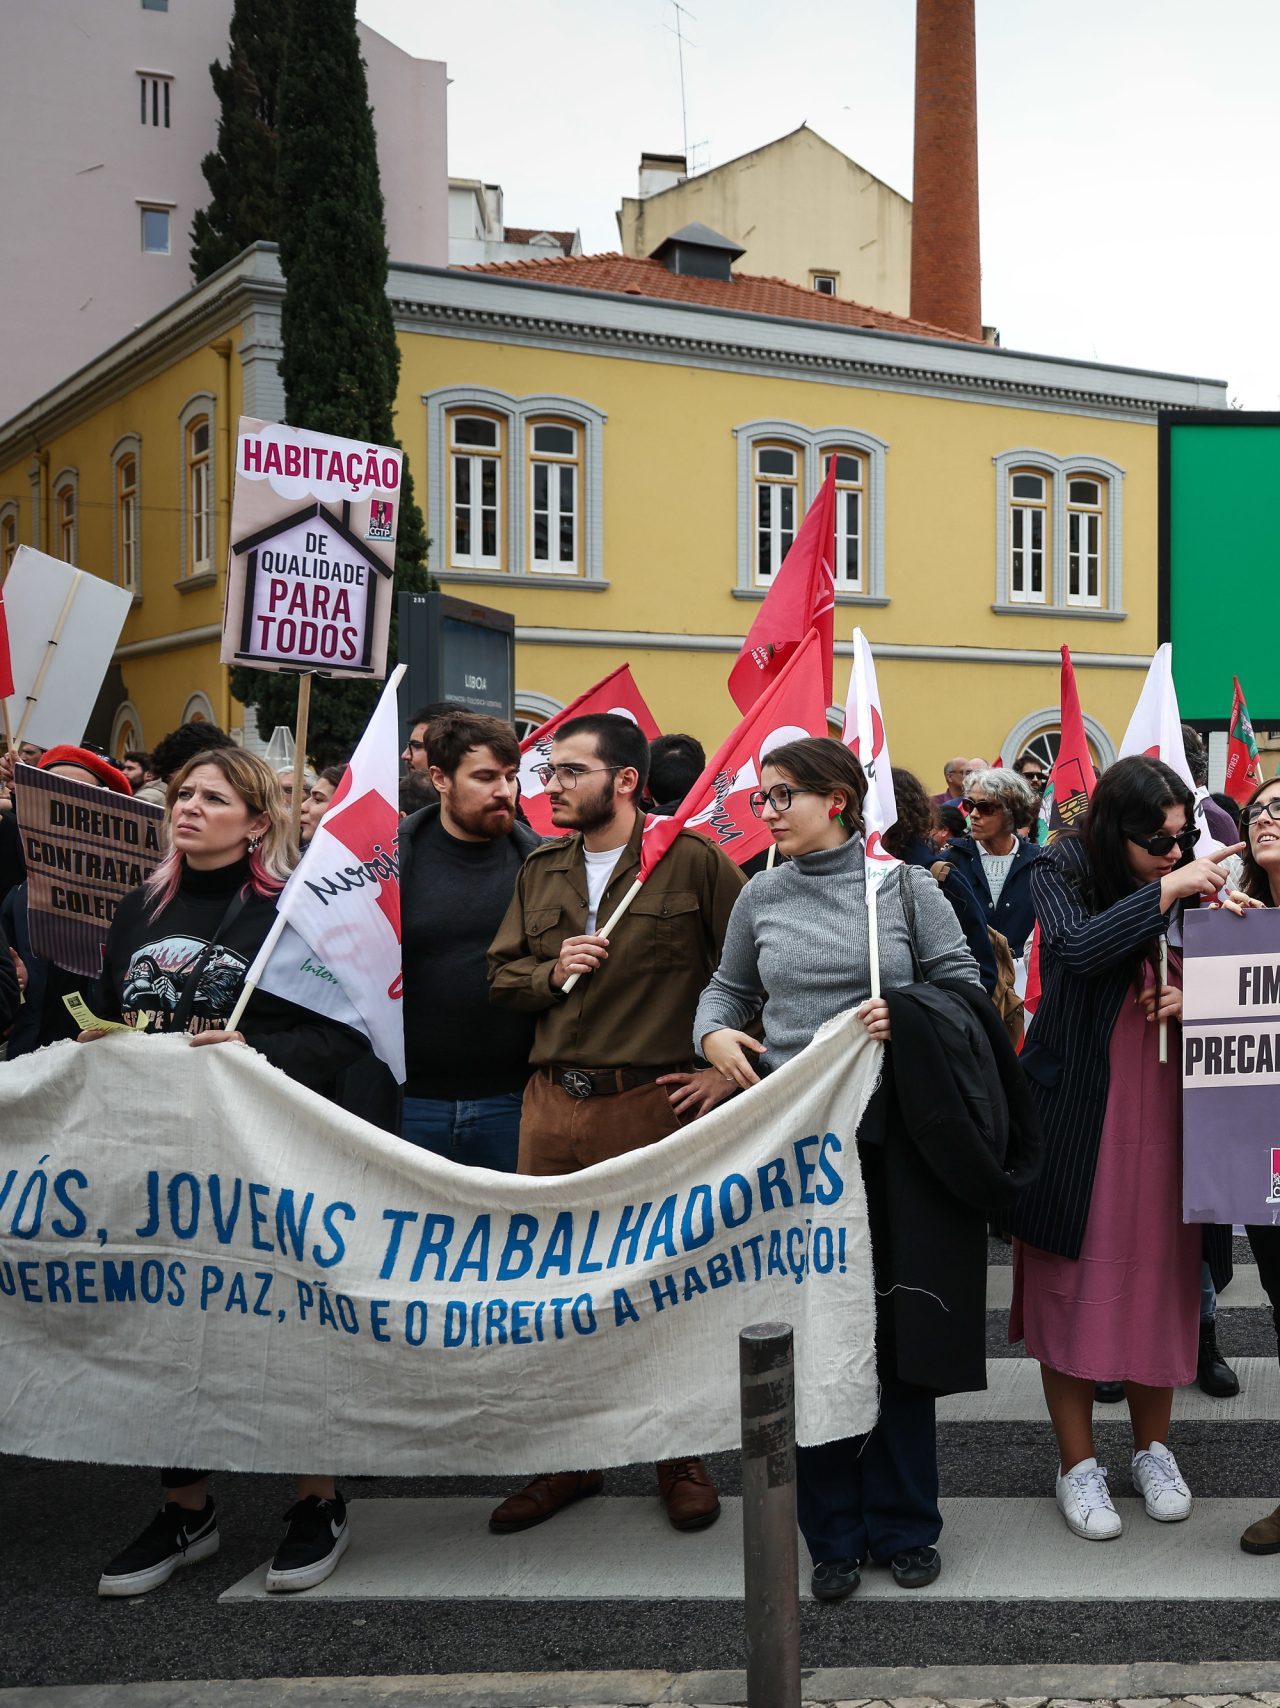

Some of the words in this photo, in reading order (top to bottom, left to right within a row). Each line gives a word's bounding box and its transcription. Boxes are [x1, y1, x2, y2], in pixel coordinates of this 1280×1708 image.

[243, 438, 399, 492] HABITAÇÃO
[306, 532, 328, 556] DE
[369, 527, 391, 537] CGTP
[261, 551, 365, 586] QUALIDADE
[268, 578, 351, 623] PARA
[257, 615, 358, 661] TODOS
[50, 800, 139, 845] DIREITO
[136, 1171, 356, 1269] JOVENS
[379, 1132, 844, 1283] TRABALHADORES
[0, 1260, 186, 1306] UEREMOS
[202, 1266, 287, 1324] PAZ,
[299, 1281, 359, 1335] PÃO
[371, 1300, 391, 1342] E
[406, 1300, 428, 1348] O
[444, 1293, 597, 1348] DIREITO
[614, 1288, 641, 1327] A
